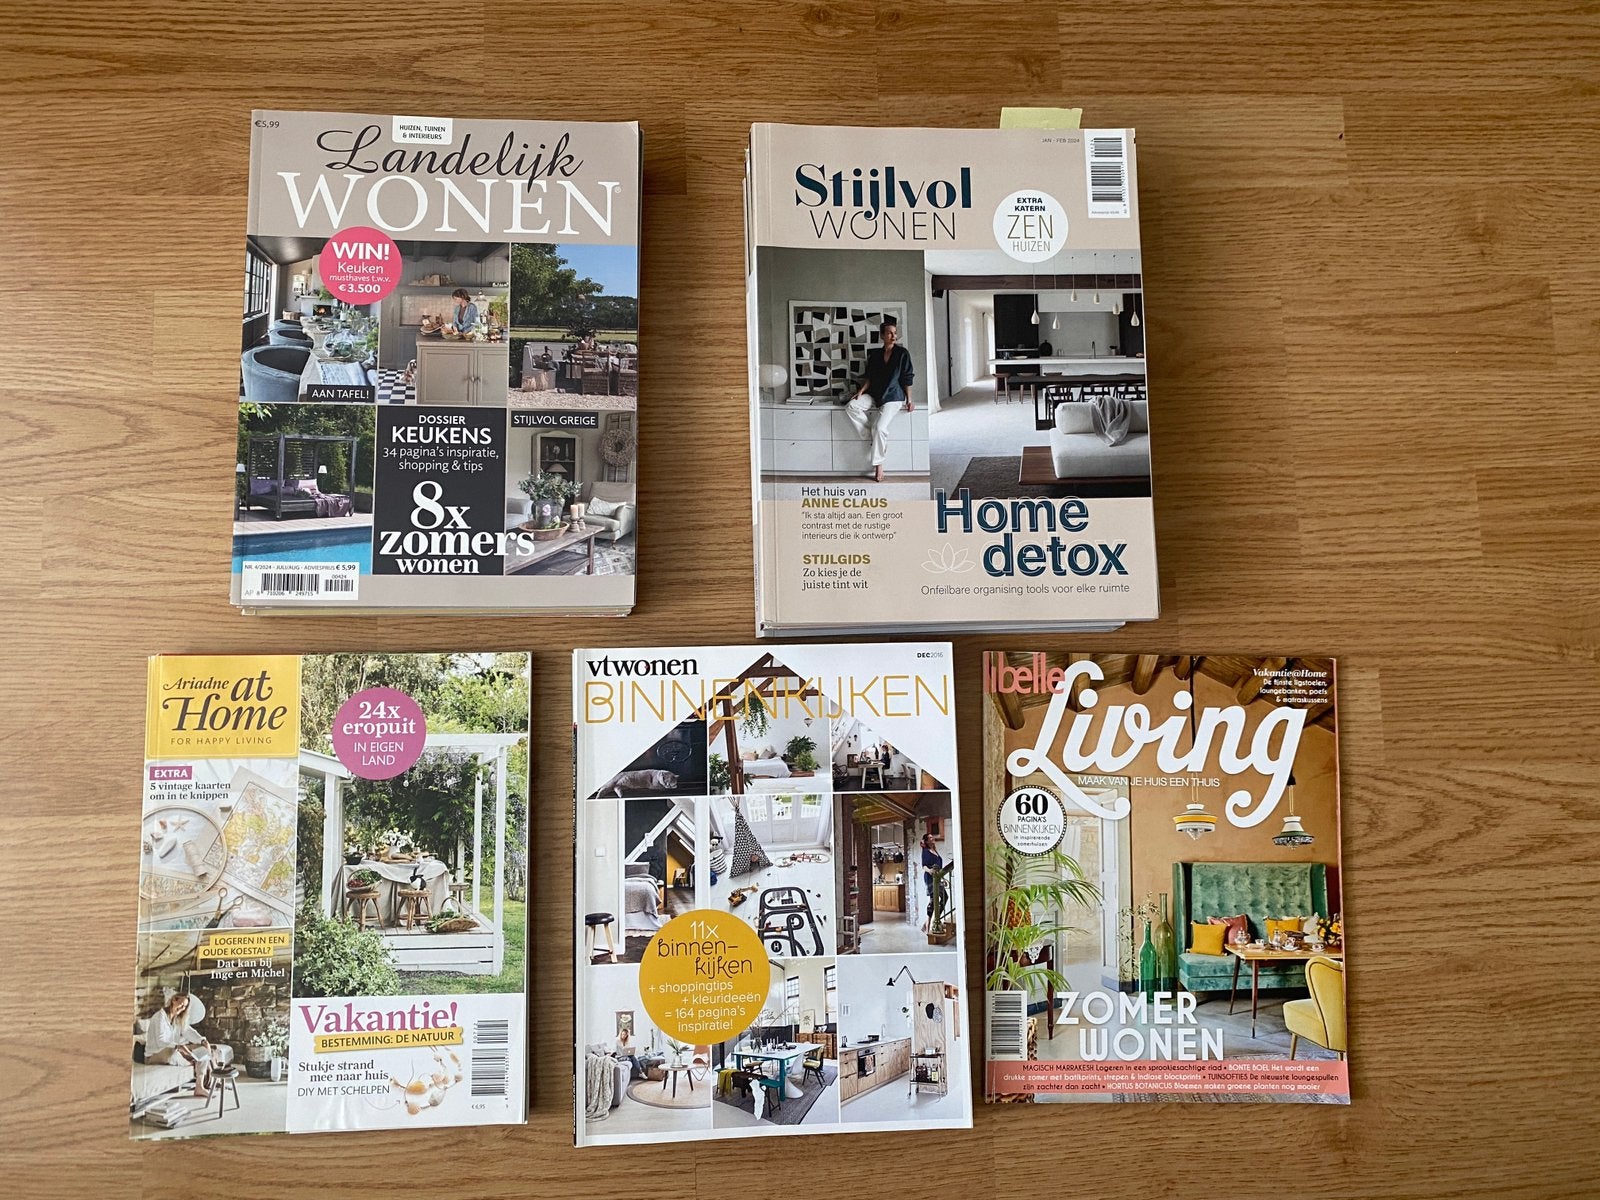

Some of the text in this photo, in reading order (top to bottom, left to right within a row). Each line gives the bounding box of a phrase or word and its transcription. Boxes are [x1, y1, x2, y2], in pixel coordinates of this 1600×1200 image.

[254, 119, 280, 128] €5,99
[399, 124, 422, 132] HUIZEN,
[316, 124, 584, 194] Landelijk
[795, 163, 972, 221] Stijlvol
[276, 171, 620, 236] WONEN
[1014, 204, 1046, 212] KATERN
[809, 210, 956, 241] WONEN
[1007, 214, 1054, 240] ZEN
[331, 241, 390, 261] WIN!
[1012, 240, 1050, 252] HUIZEN
[337, 262, 384, 274] Keuken
[371, 275, 391, 283] t.w.v.
[311, 388, 369, 400] AAN TAFEL!
[418, 414, 466, 425] DOSSIER
[513, 414, 596, 426] STIJLVOL GREIGE
[391, 426, 492, 444] KEUKENS
[382, 446, 500, 460] 34 pagina's inspiratie,
[398, 459, 484, 473] shopping & tips
[801, 486, 867, 496] Het huis van
[410, 480, 472, 530] 8x
[801, 497, 888, 508] ANNE CLAUS
[813, 512, 826, 520] sta
[827, 511, 846, 521] altijd
[847, 512, 864, 520] aan.
[865, 511, 880, 520] Een
[882, 511, 903, 521] groot
[934, 487, 1089, 534] Home
[801, 521, 890, 531] contrast met de rustige
[801, 531, 838, 540] interieurs
[839, 531, 852, 540] die
[853, 531, 860, 540] ik
[379, 530, 536, 557] zomers
[803, 554, 871, 564] STIJLGIDS
[981, 532, 1129, 578] detox
[395, 557, 480, 574] wonen
[803, 567, 862, 578] Zo kies je de
[802, 580, 868, 591] juiste tint wit
[920, 583, 1130, 596] Onfeilbare organising tools voor elke ruimte
[586, 655, 700, 677] vtwonen
[983, 650, 1066, 694] libelle
[1252, 668, 1328, 678] Vakantie@Home
[162, 670, 273, 702] Ariadne at
[584, 674, 948, 724] BINNENKIJKEN
[162, 692, 288, 731] Home
[358, 701, 400, 719] 24x
[342, 717, 416, 738] eropuit
[170, 736, 272, 745] FOR HAPPY LIVING
[354, 741, 404, 753] IN EIGEN
[1006, 660, 1308, 828] Living
[362, 754, 396, 766] LAND
[154, 769, 188, 778] EXTRA
[149, 781, 231, 792] 5 vintage kaarten
[1077, 776, 1220, 787] MAAK VAN JE HUIS EEN THUIS
[167, 792, 176, 800] in
[179, 792, 188, 800] te
[189, 791, 229, 801] knippen
[1015, 793, 1048, 816] 60
[1017, 815, 1047, 823] PAGINA'S
[1003, 823, 1060, 834] BINNENKIJKEN
[689, 920, 719, 939] 11x
[214, 936, 285, 946] LOGEREN IN EEN
[202, 946, 271, 956] OUDE KOESTAL?
[217, 958, 272, 968] Dat kan bij
[695, 955, 752, 979] kijken
[210, 970, 234, 980] Inge
[250, 967, 285, 978] Michel
[659, 981, 734, 994] shoppingtips
[692, 993, 761, 1005] kleurideeën
[675, 1005, 746, 1020] 164 pagina's
[1056, 991, 1198, 1025] ZOMER
[298, 1001, 458, 1034] Vakantie!
[678, 1019, 733, 1033] inspiratie!
[321, 1031, 455, 1048] BESTEMMING: DE NATUUR
[1079, 1027, 1224, 1061] WONEN
[298, 1060, 374, 1073] Stukje strand
[1095, 1064, 1124, 1072] Logeren
[310, 1070, 389, 1082] mee naar huis
[297, 1085, 390, 1097] DIY MET SCHELPEN
